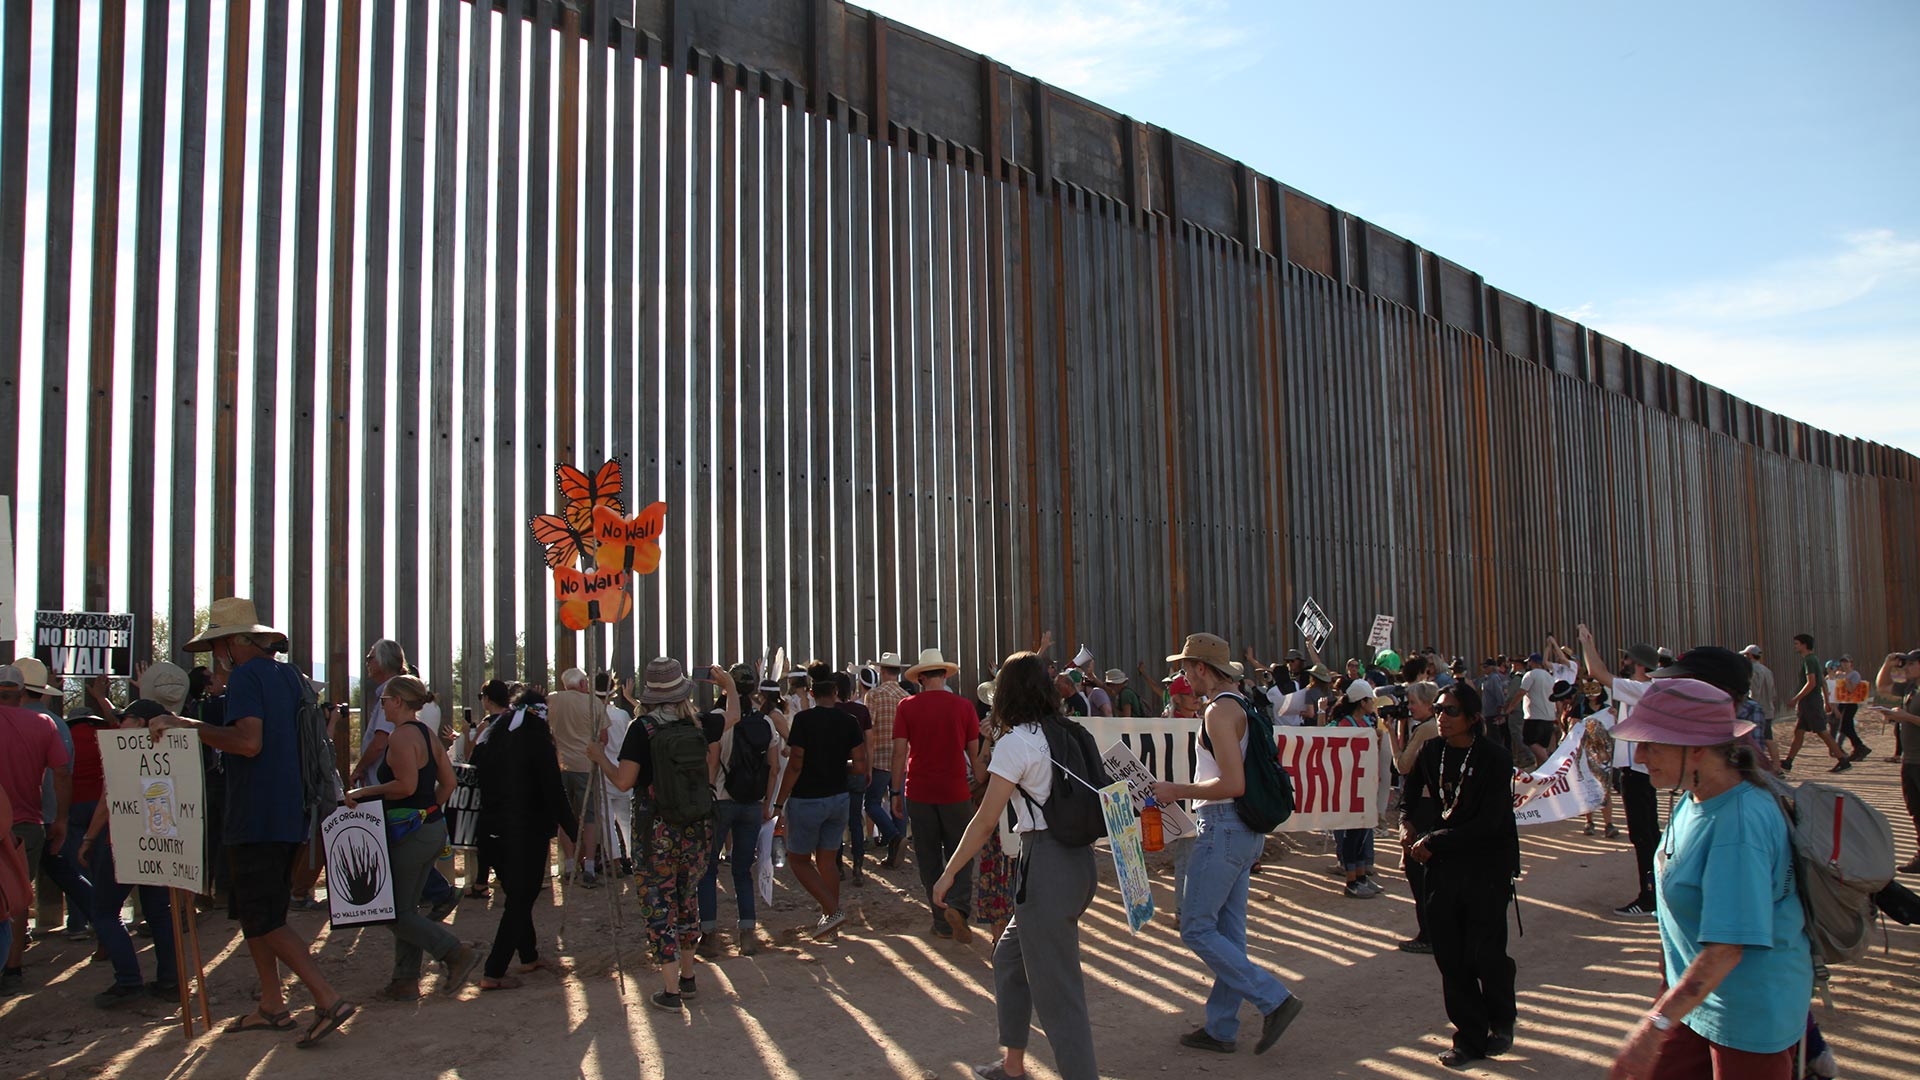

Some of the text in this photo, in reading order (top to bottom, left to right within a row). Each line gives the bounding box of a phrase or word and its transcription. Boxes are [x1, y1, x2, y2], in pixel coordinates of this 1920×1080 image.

[601, 519, 655, 541] No Wall
[560, 573, 620, 595] No Wall
[38, 627, 130, 648] NO BORDER
[50, 647, 116, 675] WALL
[116, 734, 189, 751] DOES THIS
[139, 752, 171, 776] ASS
[1103, 755, 1121, 773] THE
[1276, 735, 1370, 814] HATE
[448, 785, 471, 809] NO
[112, 800, 195, 818] MAKE MY
[1105, 791, 1135, 838] WATER
[323, 811, 382, 834] SAVE ORGAN PIPE
[138, 836, 184, 855] COUNTRY
[138, 859, 200, 881] LOOK SMALL?
[342, 910, 359, 918] WALLS
